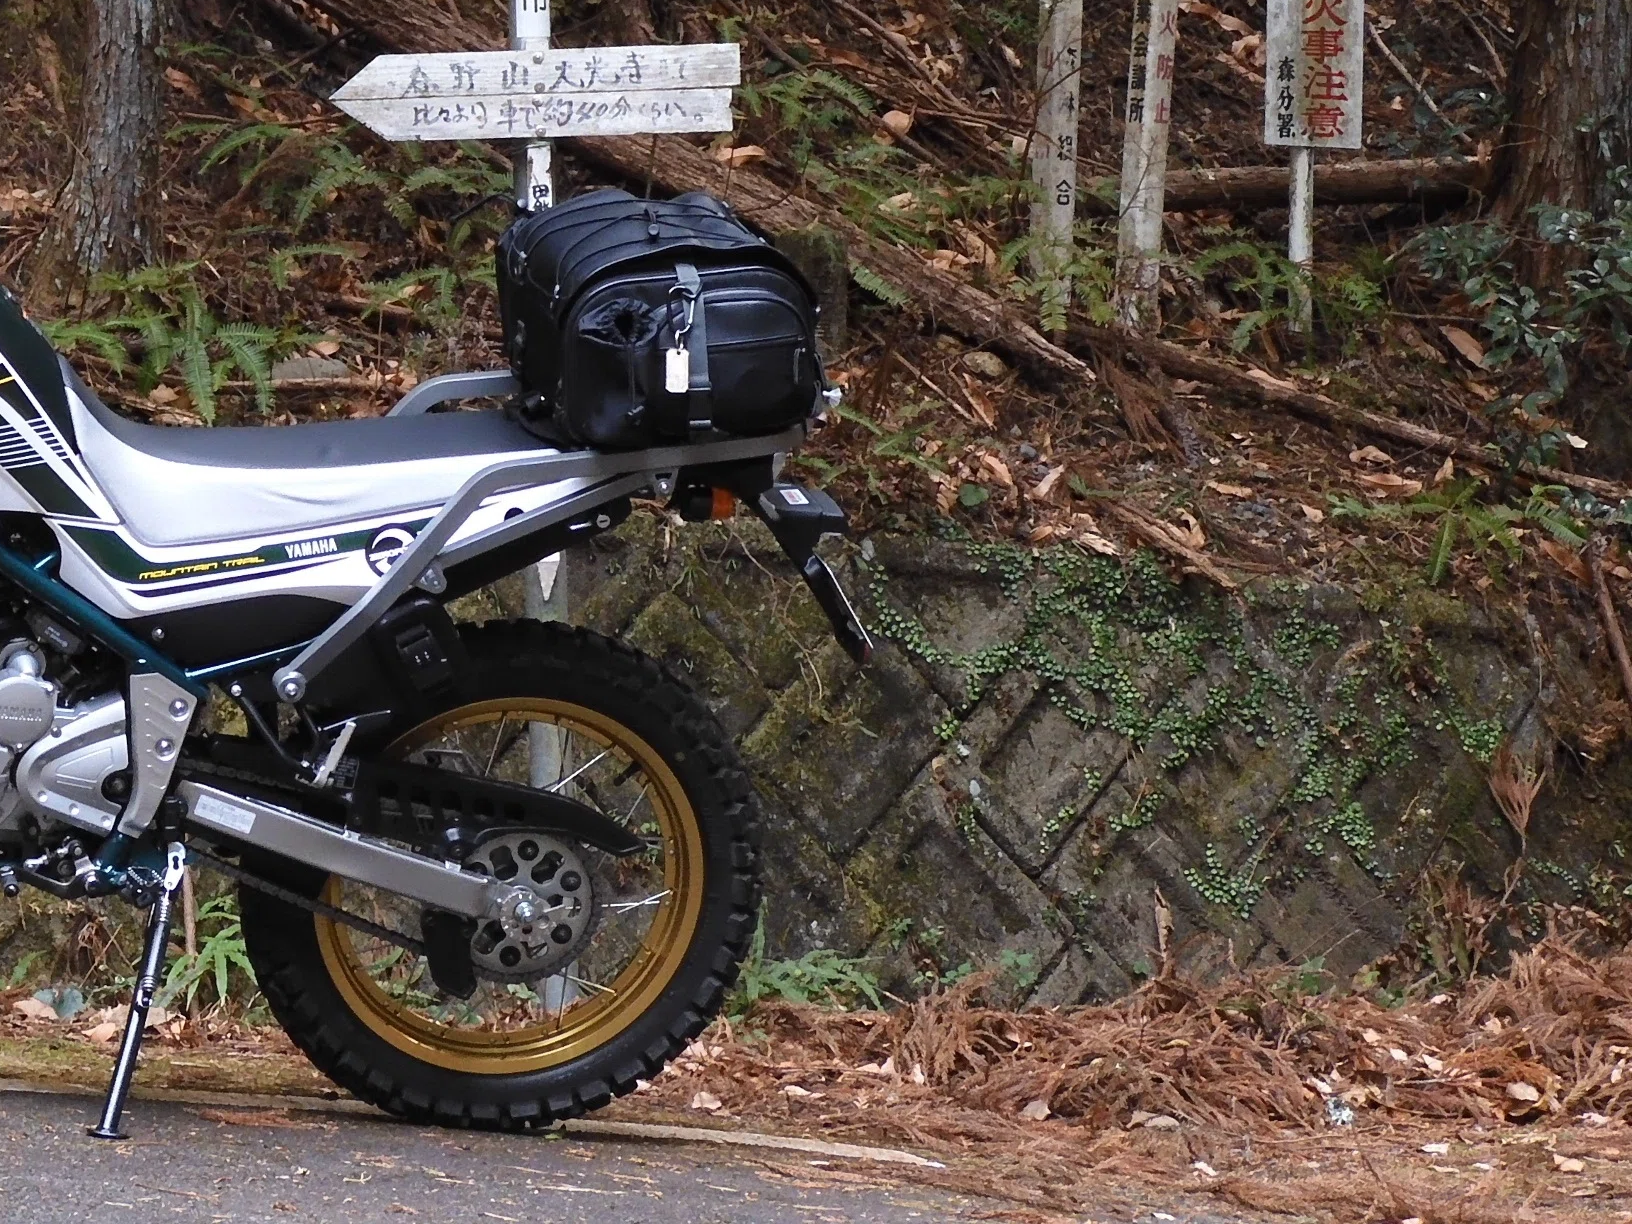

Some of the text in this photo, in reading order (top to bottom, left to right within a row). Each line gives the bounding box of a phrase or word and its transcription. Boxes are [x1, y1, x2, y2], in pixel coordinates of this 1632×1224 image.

[285, 538, 338, 559] YAMAHA
[139, 555, 265, 580] MOUNTAIN TRAIL
